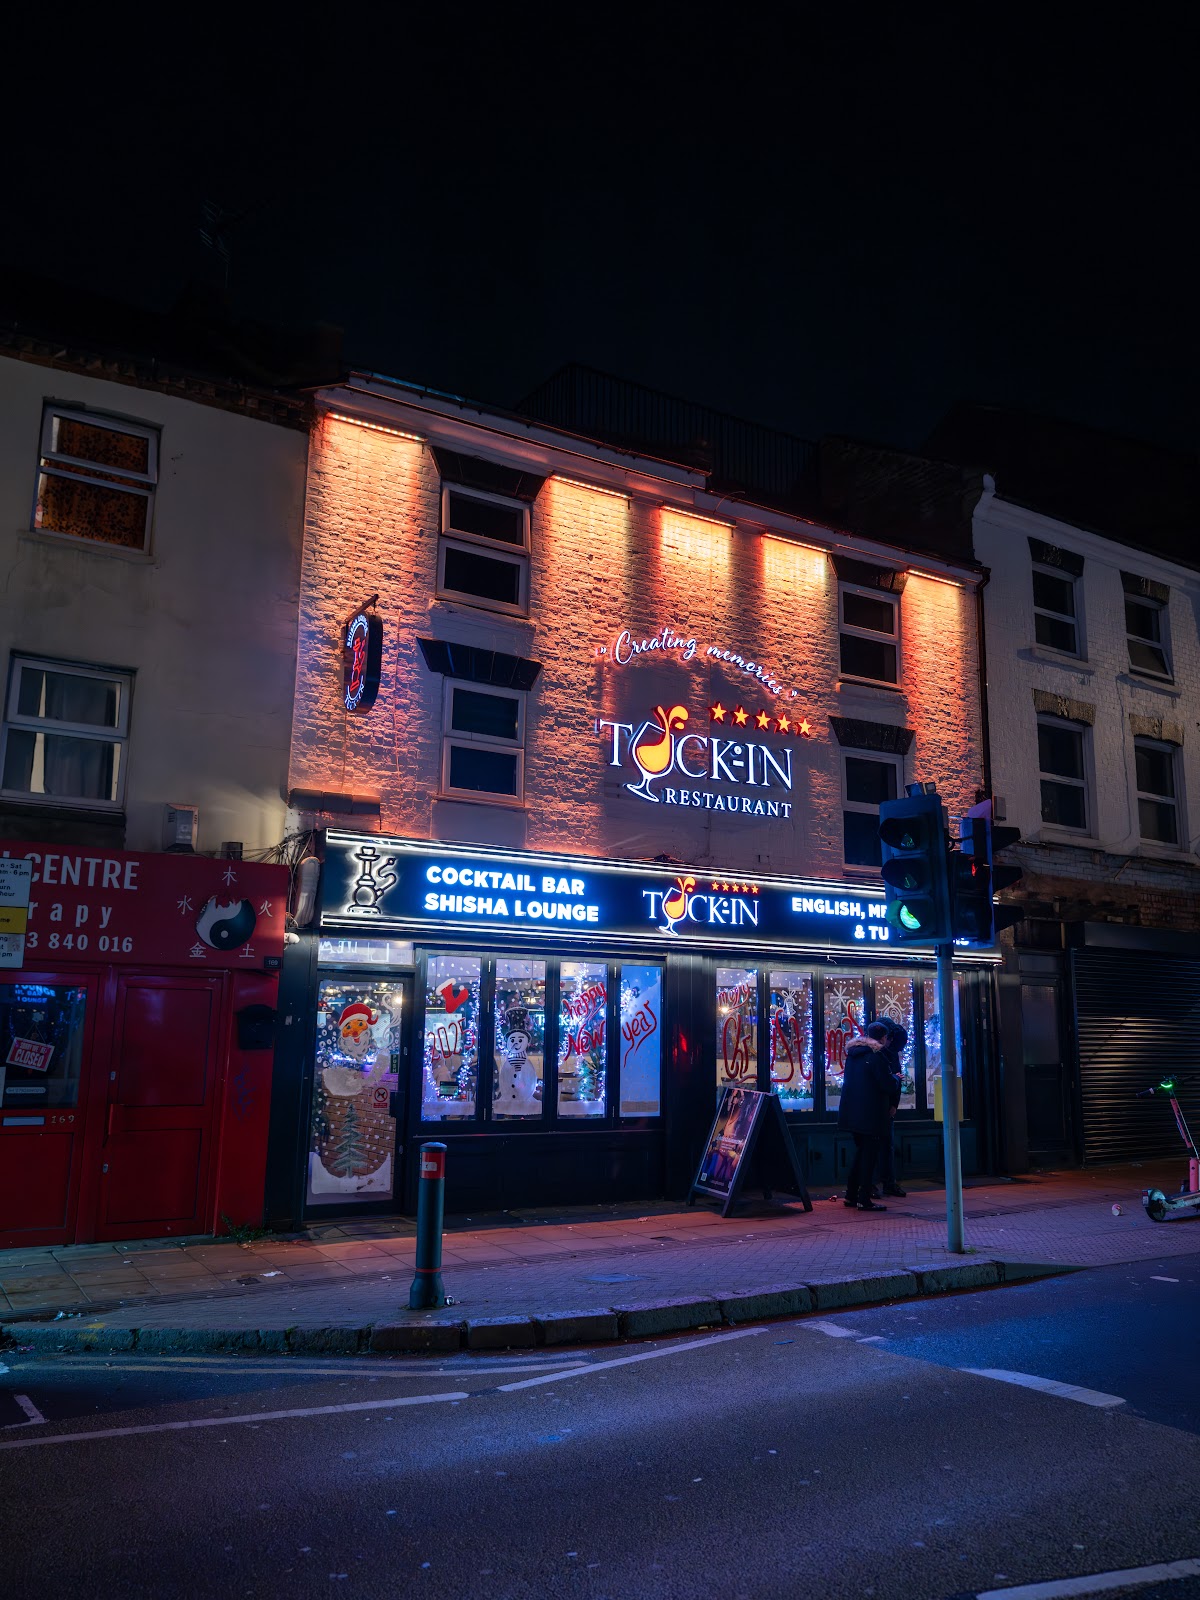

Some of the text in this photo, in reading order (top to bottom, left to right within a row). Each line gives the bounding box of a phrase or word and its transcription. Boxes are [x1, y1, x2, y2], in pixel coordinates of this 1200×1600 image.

[665, 788, 792, 818] RESTAURANT
[23, 852, 140, 890] CENTRE
[222, 866, 237, 887] 木
[426, 866, 585, 896] COCKTAIL BAR
[177, 895, 194, 915] 水
[258, 900, 273, 918] 火
[424, 892, 599, 922] SHISHA LOUNGE
[792, 897, 865, 920] ENGLISH,
[26, 931, 133, 953] 3 840 016
[854, 925, 889, 941] & TU
[189, 941, 206, 958] 金
[239, 943, 255, 958] 土
[561, 982, 608, 1025] happy
[427, 1017, 475, 1063] 2025
[14, 1048, 45, 1067] CLOSED
[51, 1115, 75, 1124] 169
